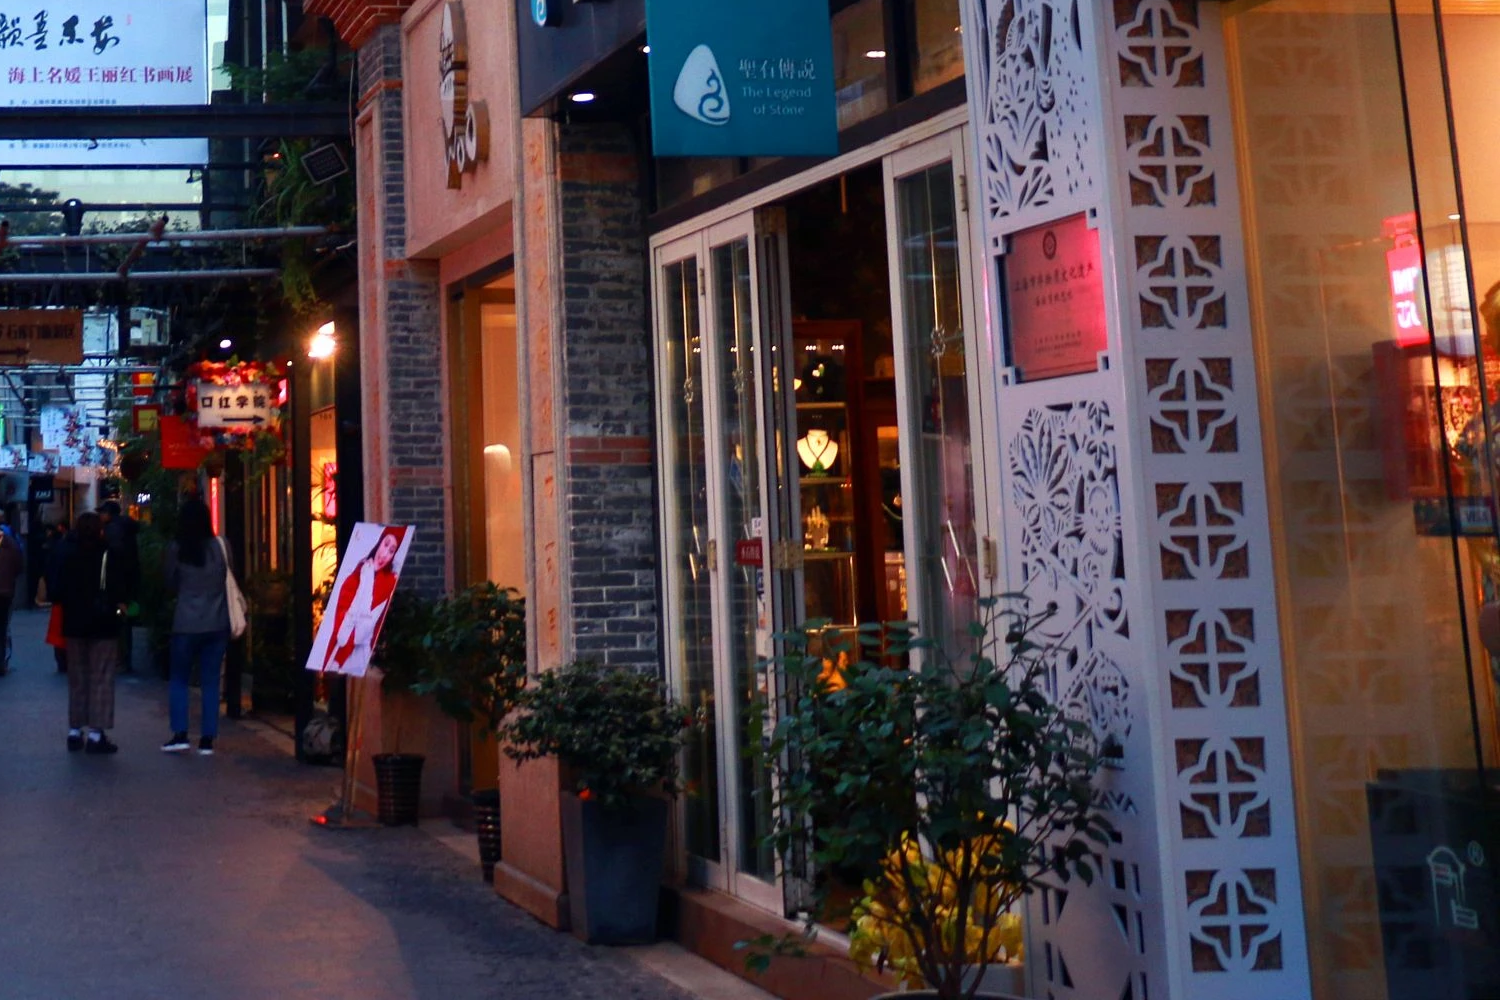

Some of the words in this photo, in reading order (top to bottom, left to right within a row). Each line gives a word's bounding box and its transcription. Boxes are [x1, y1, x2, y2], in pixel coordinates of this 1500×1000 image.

[8, 66, 193, 84] 海上名媛王丽红书画展
[742, 87, 763, 98] The
[767, 87, 812, 101] Legend
[753, 105, 765, 115] of
[770, 105, 804, 115] Stone
[202, 395, 266, 408] 口红学院
